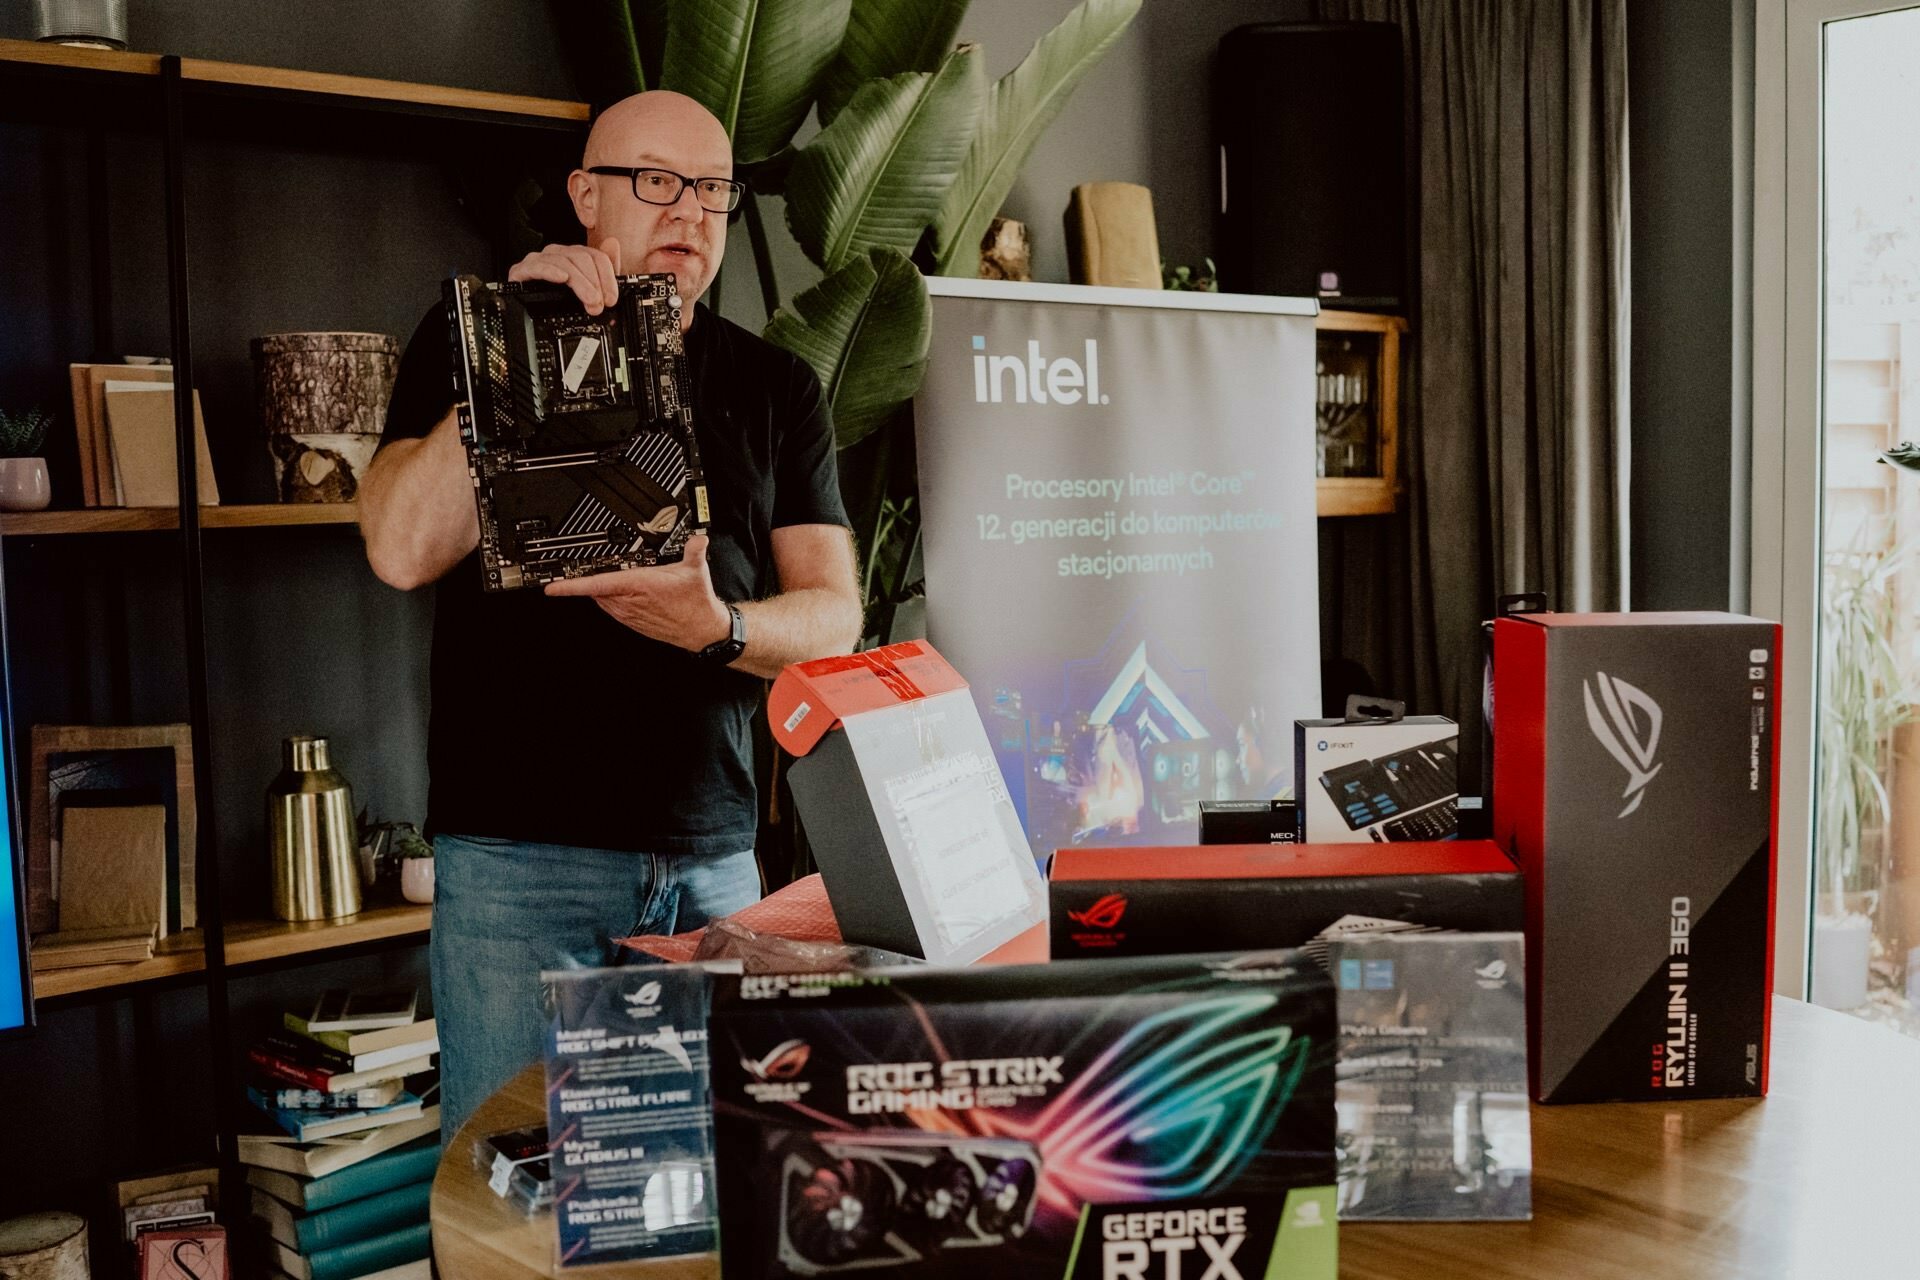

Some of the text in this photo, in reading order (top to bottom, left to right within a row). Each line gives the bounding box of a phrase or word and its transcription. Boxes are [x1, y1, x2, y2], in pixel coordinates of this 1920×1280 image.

[972, 335, 1110, 405] intel.
[1006, 474, 1124, 503] Procesory
[976, 508, 1284, 544] 12. generacji do komputerów
[1058, 547, 1214, 579] stacjonarnych
[1665, 896, 1691, 1087] RYUJIN II 360
[846, 1056, 1065, 1091] ROG STRIX
[1651, 1044, 1664, 1087] ROG
[1745, 1044, 1758, 1085] ASUS
[561, 1099, 593, 1113] ROG
[595, 1094, 641, 1110] STRIX
[847, 1087, 974, 1115] GAMING
[1102, 1206, 1247, 1241] GEFORCE
[1102, 1235, 1247, 1280] RTX
